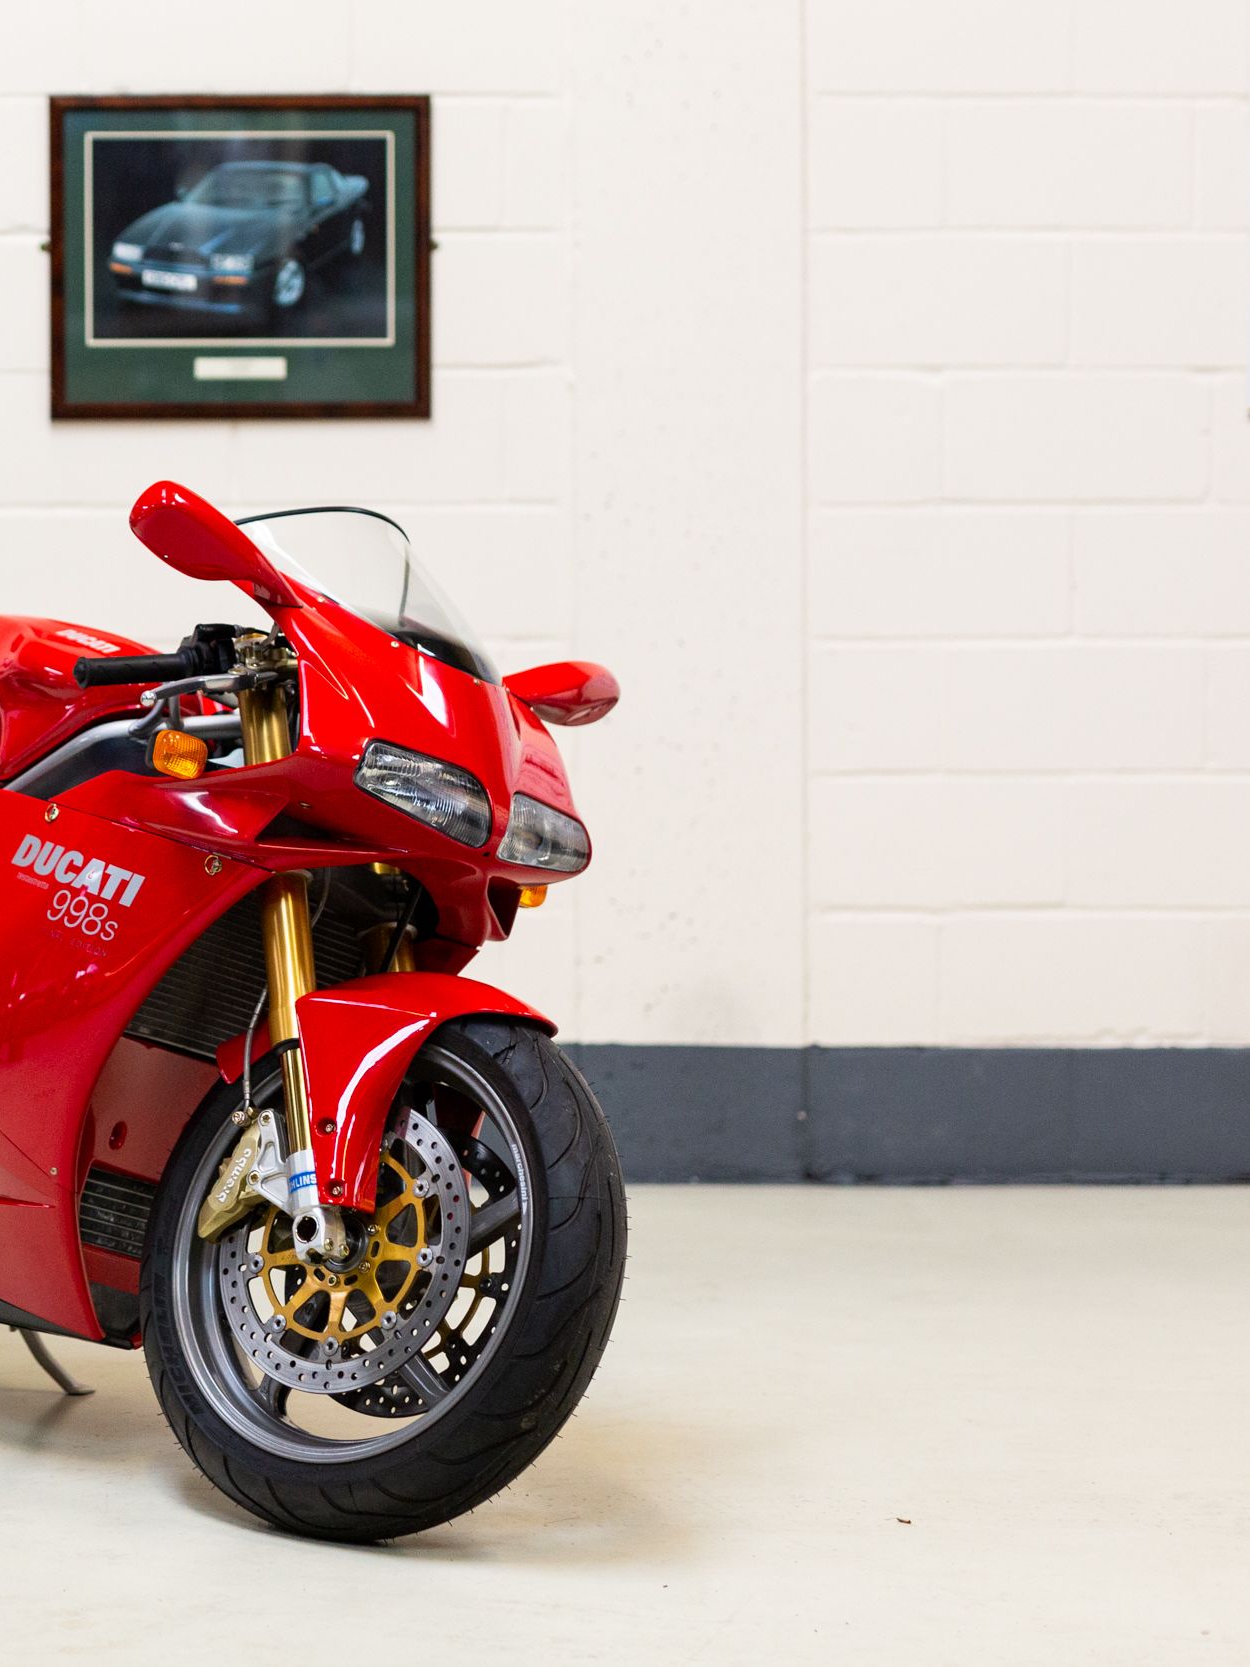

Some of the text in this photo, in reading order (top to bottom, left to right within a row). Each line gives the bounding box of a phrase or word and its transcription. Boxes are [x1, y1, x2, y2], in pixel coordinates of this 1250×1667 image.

[55, 628, 121, 654] DUCATI
[11, 833, 146, 908] DUCATI
[215, 1148, 252, 1203] brembo
[289, 1173, 317, 1192] HLINS
[511, 1143, 528, 1201] marchesini
